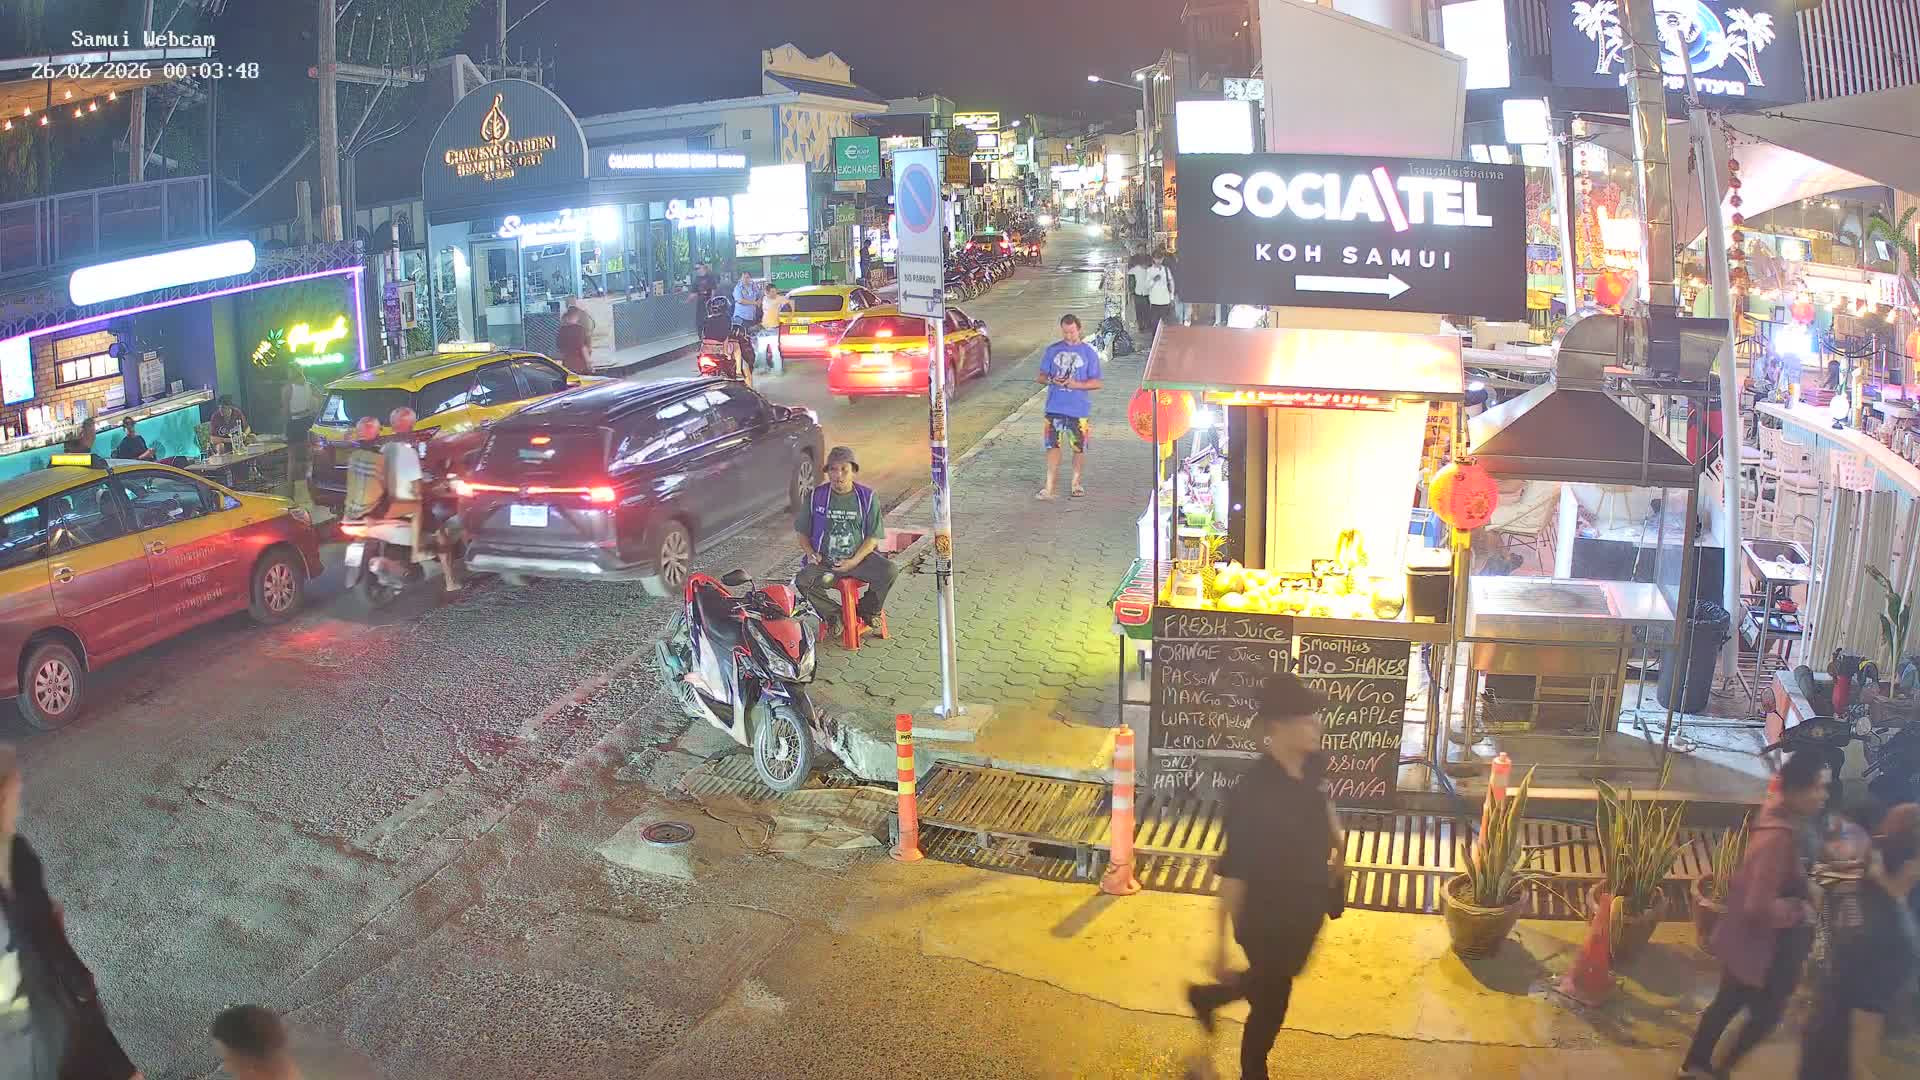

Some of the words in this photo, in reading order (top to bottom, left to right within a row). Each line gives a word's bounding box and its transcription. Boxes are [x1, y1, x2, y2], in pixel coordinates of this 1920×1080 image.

[837, 163, 879, 175] EXCHANGE
[1255, 243, 1322, 263] KOH
[1342, 245, 1451, 269] SAMUI
[771, 270, 811, 281] EXCHANGE
[1164, 614, 1227, 639] FRESH
[1341, 656, 1408, 676] SHAKES
[1153, 771, 1205, 791] HAPPY
